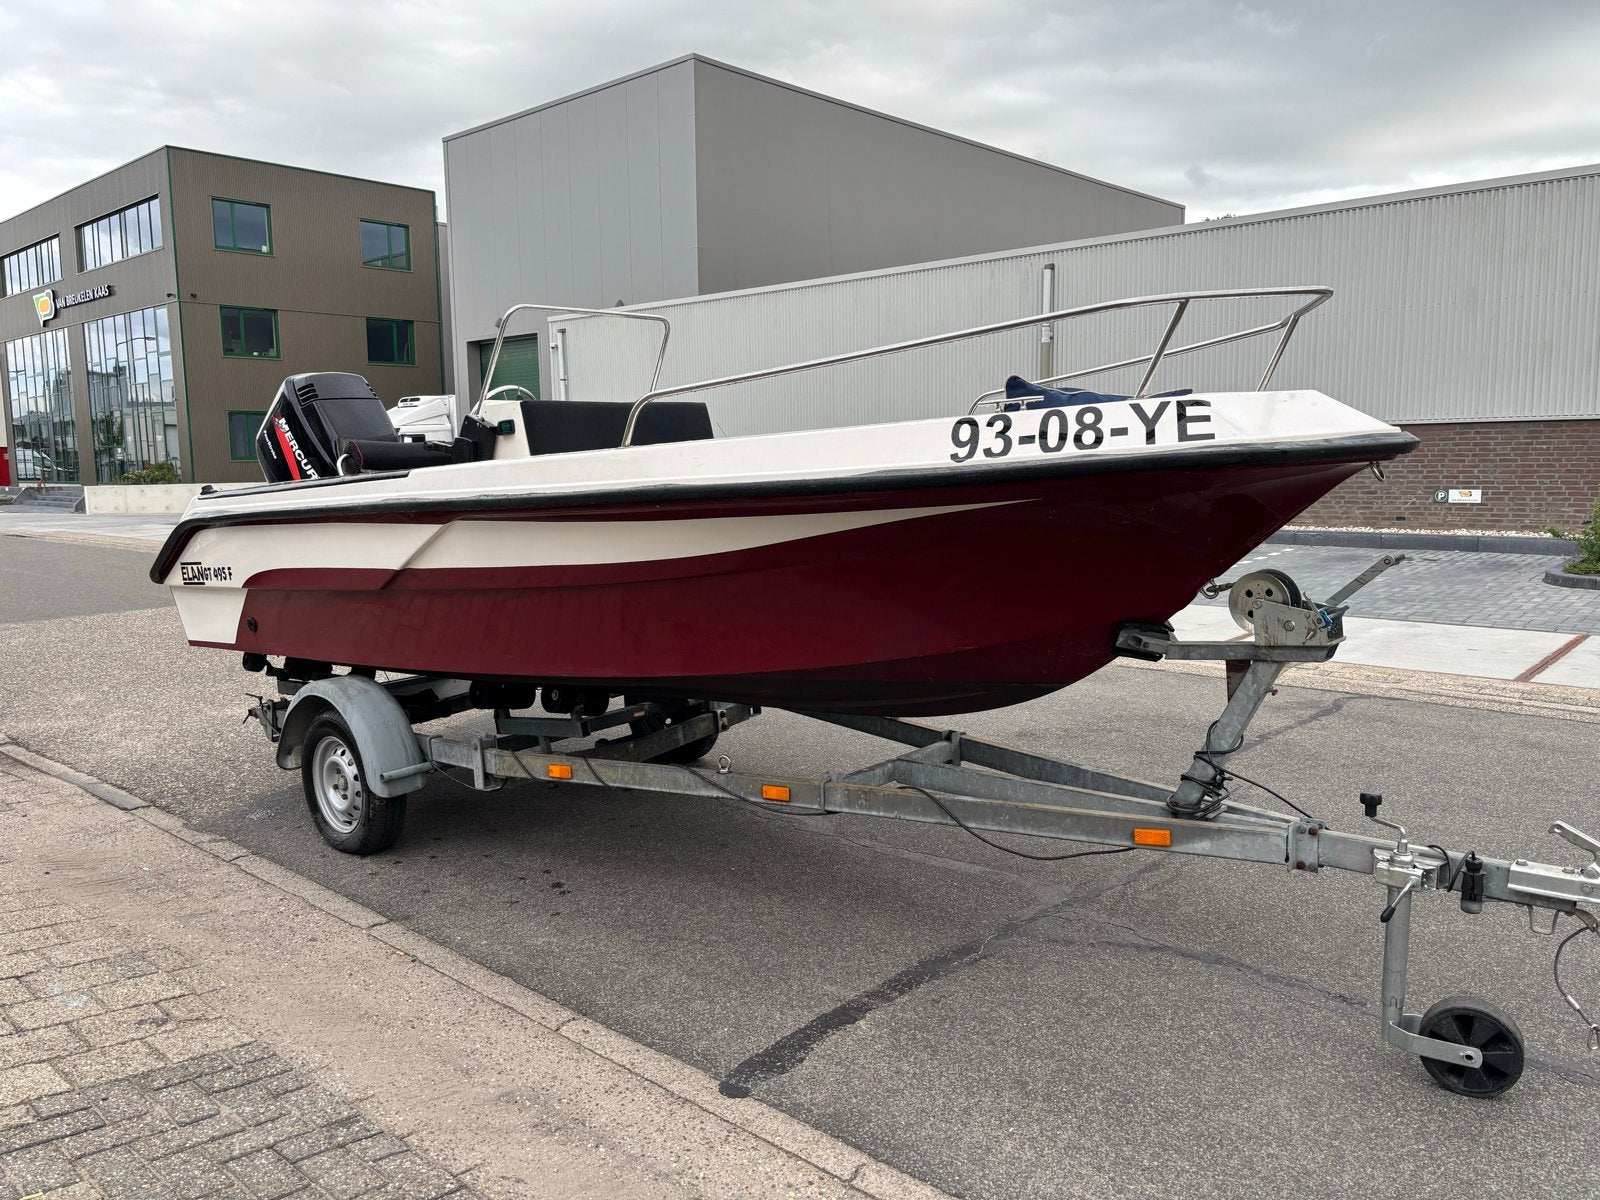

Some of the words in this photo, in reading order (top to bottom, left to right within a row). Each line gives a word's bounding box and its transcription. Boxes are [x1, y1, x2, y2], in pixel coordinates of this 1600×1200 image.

[55, 297, 66, 309] VAN
[66, 288, 94, 307] BREUKELEN
[93, 284, 109, 299] KAAS
[278, 417, 319, 480] MERCUR
[950, 400, 1216, 464] 93-08-YE
[181, 565, 205, 582] ELAN
[213, 566, 228, 582] 495
[227, 566, 233, 581] F
